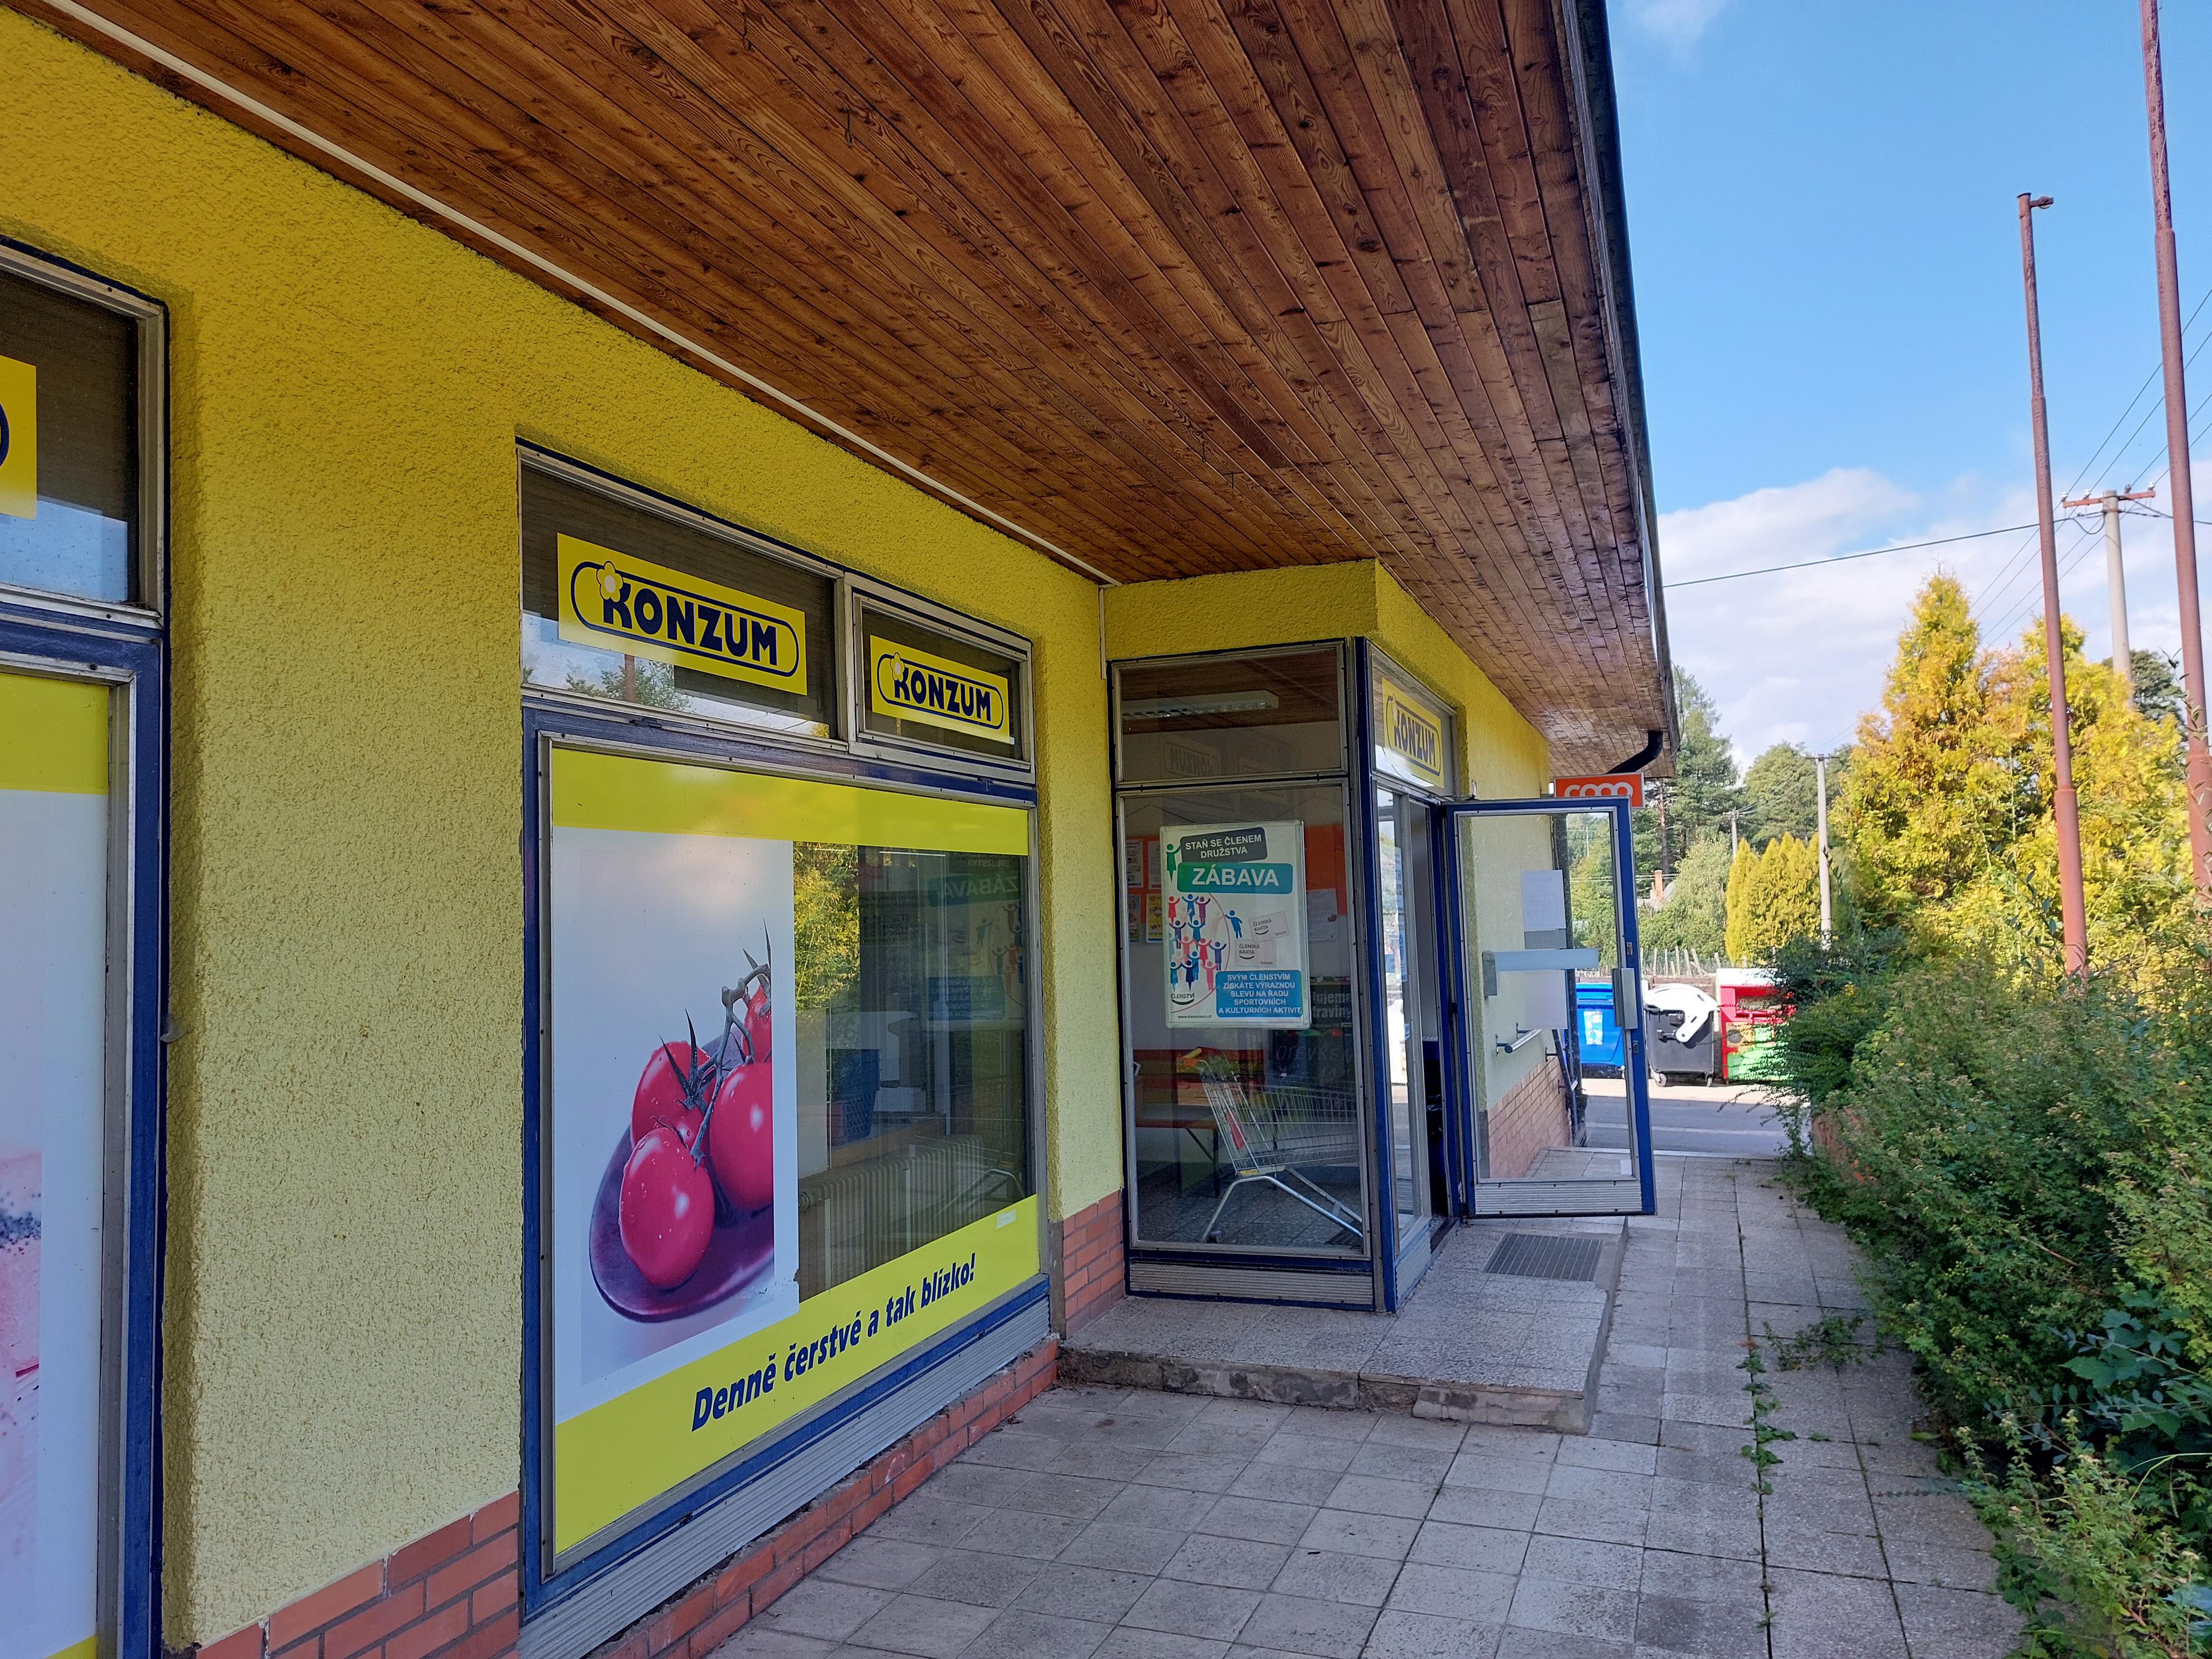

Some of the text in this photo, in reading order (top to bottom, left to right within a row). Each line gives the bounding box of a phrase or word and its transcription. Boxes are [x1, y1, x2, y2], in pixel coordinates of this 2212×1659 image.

[603, 582, 778, 666] KONZUM
[894, 666, 992, 722] KONZUM
[1394, 709, 1437, 768] KONZUM
[1185, 834, 1262, 850] STAŇ SE ČLENEM
[1201, 846, 1248, 858] DRUŽSTVA
[1192, 864, 1280, 886] ZÁBAVA
[691, 1251, 976, 1432] Denně čerstvé a tak blízko!
